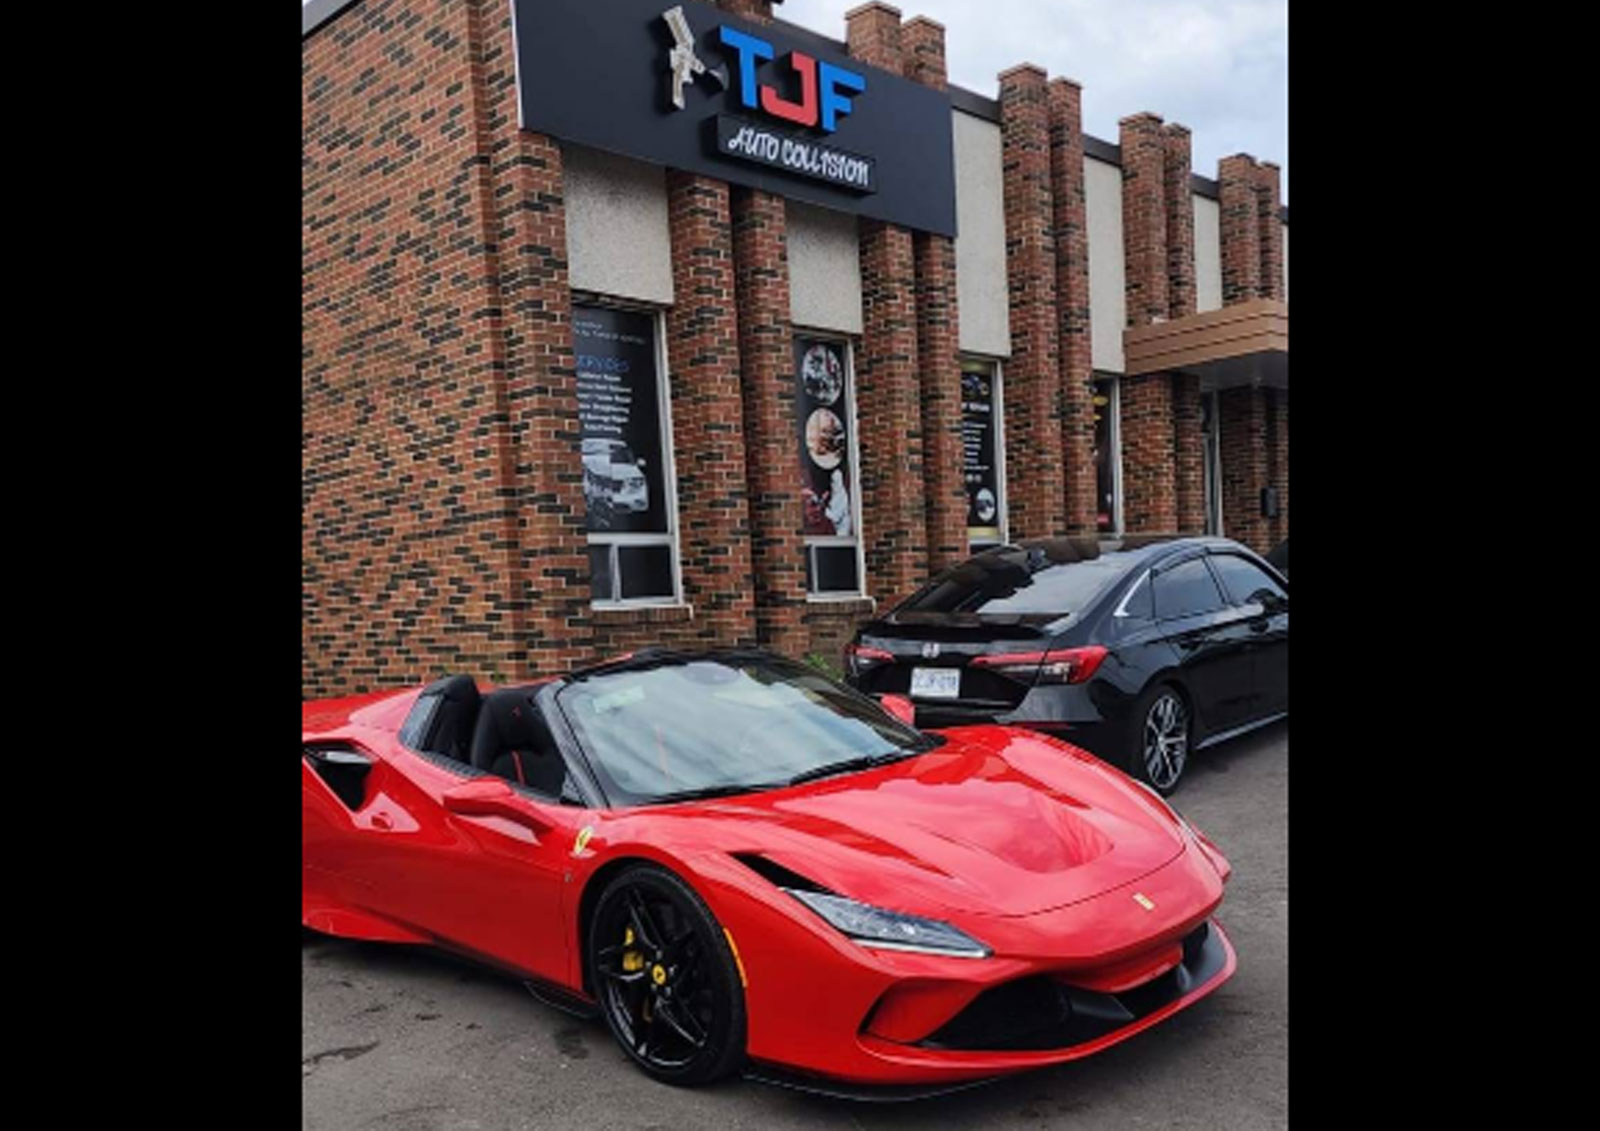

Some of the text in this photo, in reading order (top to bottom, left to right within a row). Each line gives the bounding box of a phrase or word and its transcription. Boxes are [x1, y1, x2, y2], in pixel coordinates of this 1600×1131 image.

[720, 25, 866, 133] TJF
[728, 127, 868, 186] AUTO COLLISION
